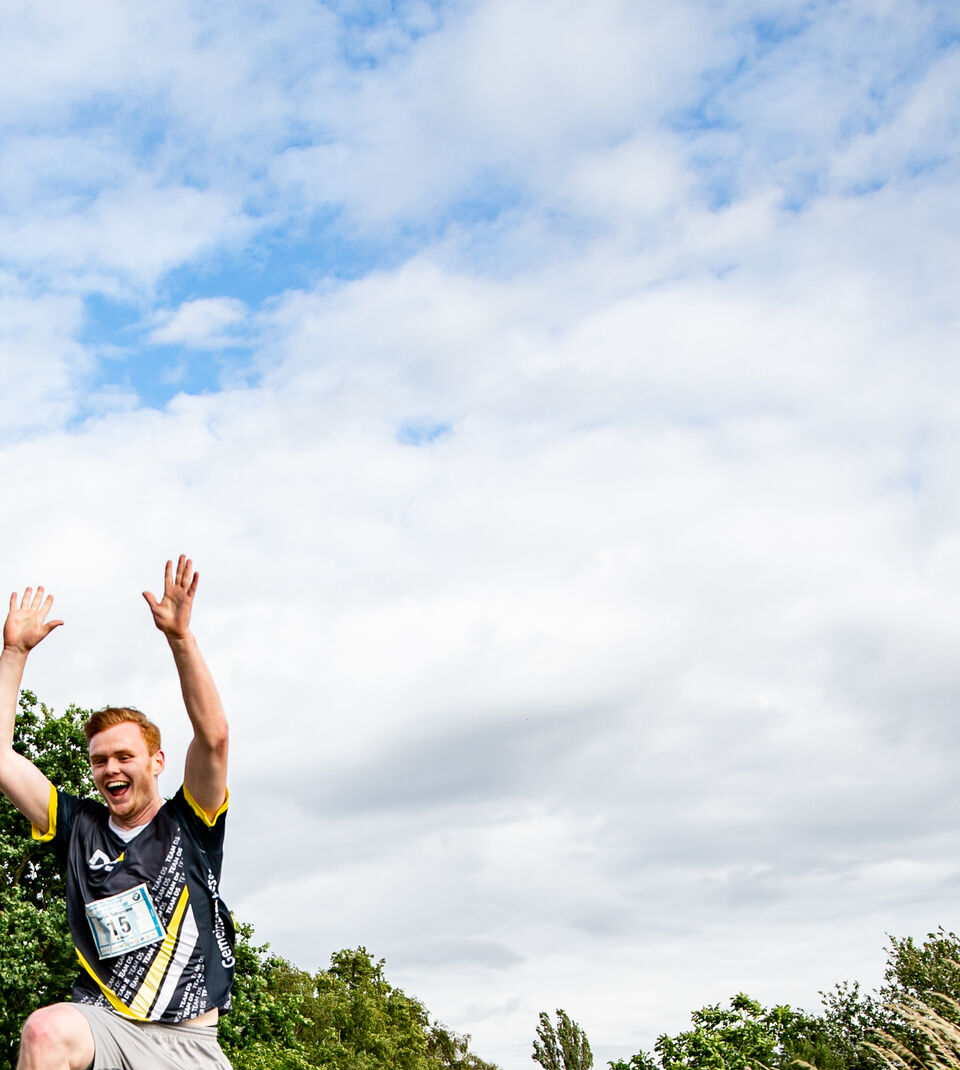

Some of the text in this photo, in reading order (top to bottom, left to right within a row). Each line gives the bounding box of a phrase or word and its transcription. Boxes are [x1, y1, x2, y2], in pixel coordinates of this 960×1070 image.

[151, 836, 180, 892] TEAM DS TEAM DS
[154, 886, 166, 904] TEAM
[163, 877, 171, 887] DS
[168, 857, 180, 874] TEAM
[176, 847, 183, 857] DS
[165, 880, 177, 899] TEAM
[165, 895, 177, 914] TEAM
[174, 887, 181, 897] DS
[106, 916, 132, 936] 15
[117, 964, 129, 978] TEAM
[126, 955, 134, 965] DS
[128, 951, 145, 976] TEAM DS
[137, 966, 145, 976] DS
[142, 947, 156, 964] TEAM
[179, 991, 189, 1009] TEAM
[185, 982, 193, 991] DS
[182, 1001, 191, 1018] TEAM
[188, 992, 195, 1002] DS
[191, 995, 200, 1012] TEAM
